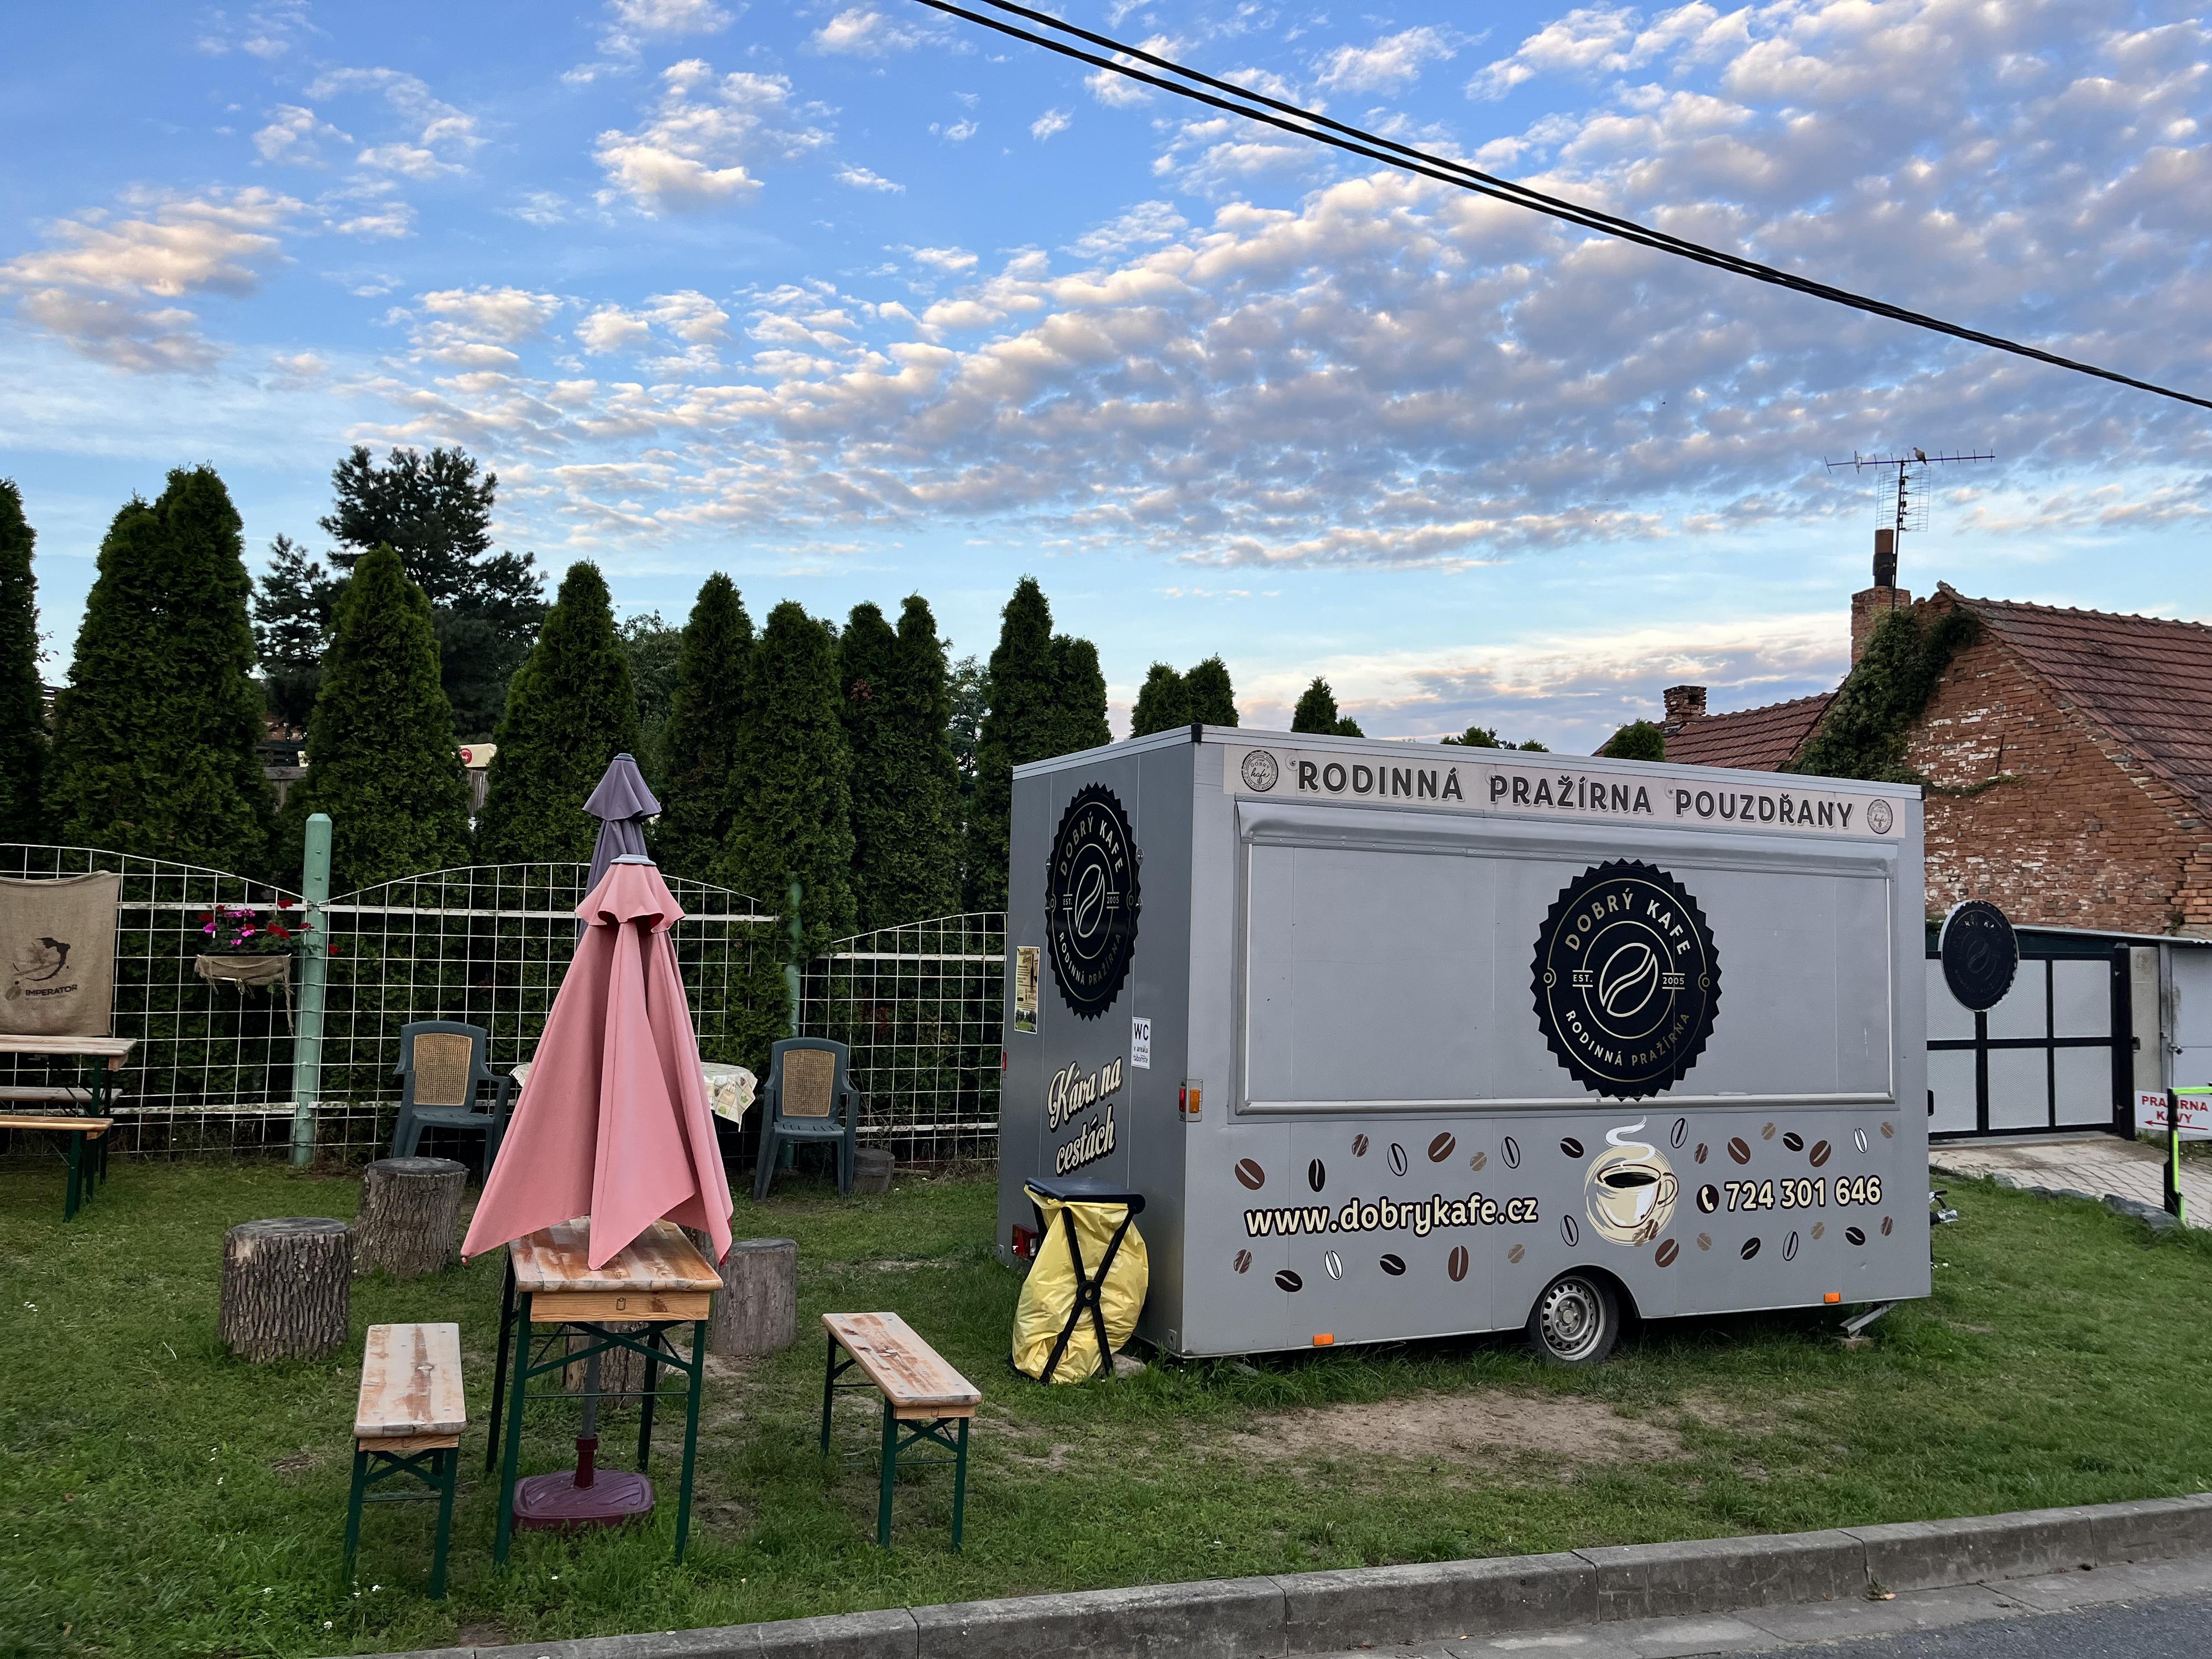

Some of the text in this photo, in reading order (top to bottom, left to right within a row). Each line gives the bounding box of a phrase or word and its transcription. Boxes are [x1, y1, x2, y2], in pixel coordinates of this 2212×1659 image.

[1298, 760, 1853, 828] RODINNÁ PRAŽÍRNA POUZDŘANY
[1060, 811, 1123, 877] DOBRÝ KAFE
[1063, 898, 1072, 906] EST.
[1107, 896, 1119, 904] 2005
[1565, 888, 1691, 955] DOBRÝ KAFE
[1059, 932, 1121, 987] RODINNÁ PRAŽÍRNA
[1573, 974, 1593, 983] EST.
[25, 984, 77, 996] IMPERATOR
[1663, 976, 1685, 985] 2005
[1134, 1022, 1149, 1041] WC
[1566, 1010, 1689, 1066] RODINNÁ PRAŽÍRNA
[1048, 1057, 1123, 1131] Káva na
[2157, 1110, 2193, 1123] KVY
[1056, 1104, 1115, 1176] cestách
[1724, 1175, 1882, 1211] 724 301 646
[1245, 1193, 1538, 1237] www.dobrykafe.cz
